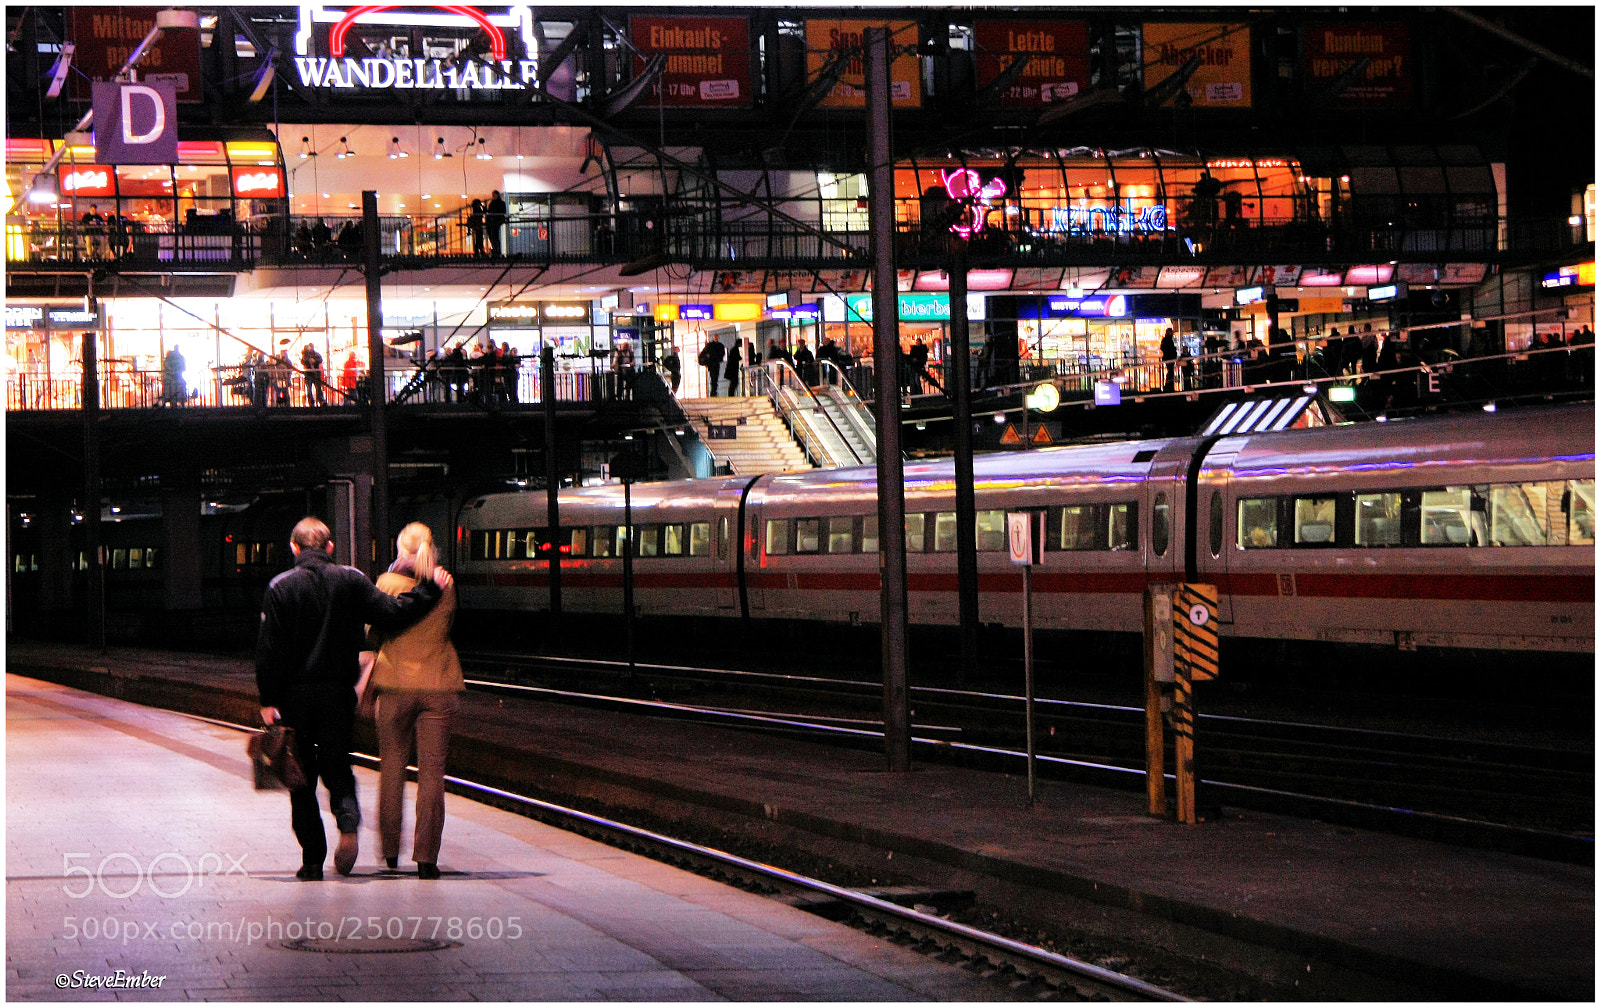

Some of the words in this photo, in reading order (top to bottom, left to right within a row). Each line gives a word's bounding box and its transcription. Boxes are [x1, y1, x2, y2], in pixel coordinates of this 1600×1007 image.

[651, 26, 729, 48] Einkaufs-
[1008, 28, 1055, 52] Letzte
[294, 57, 540, 89] WANDELHALLE
[664, 53, 723, 74] ummel
[680, 84, 696, 97] Uhr
[1022, 86, 1038, 98] Uhr
[121, 86, 166, 144] D
[1098, 381, 1111, 399] E
[1428, 372, 1441, 393] E
